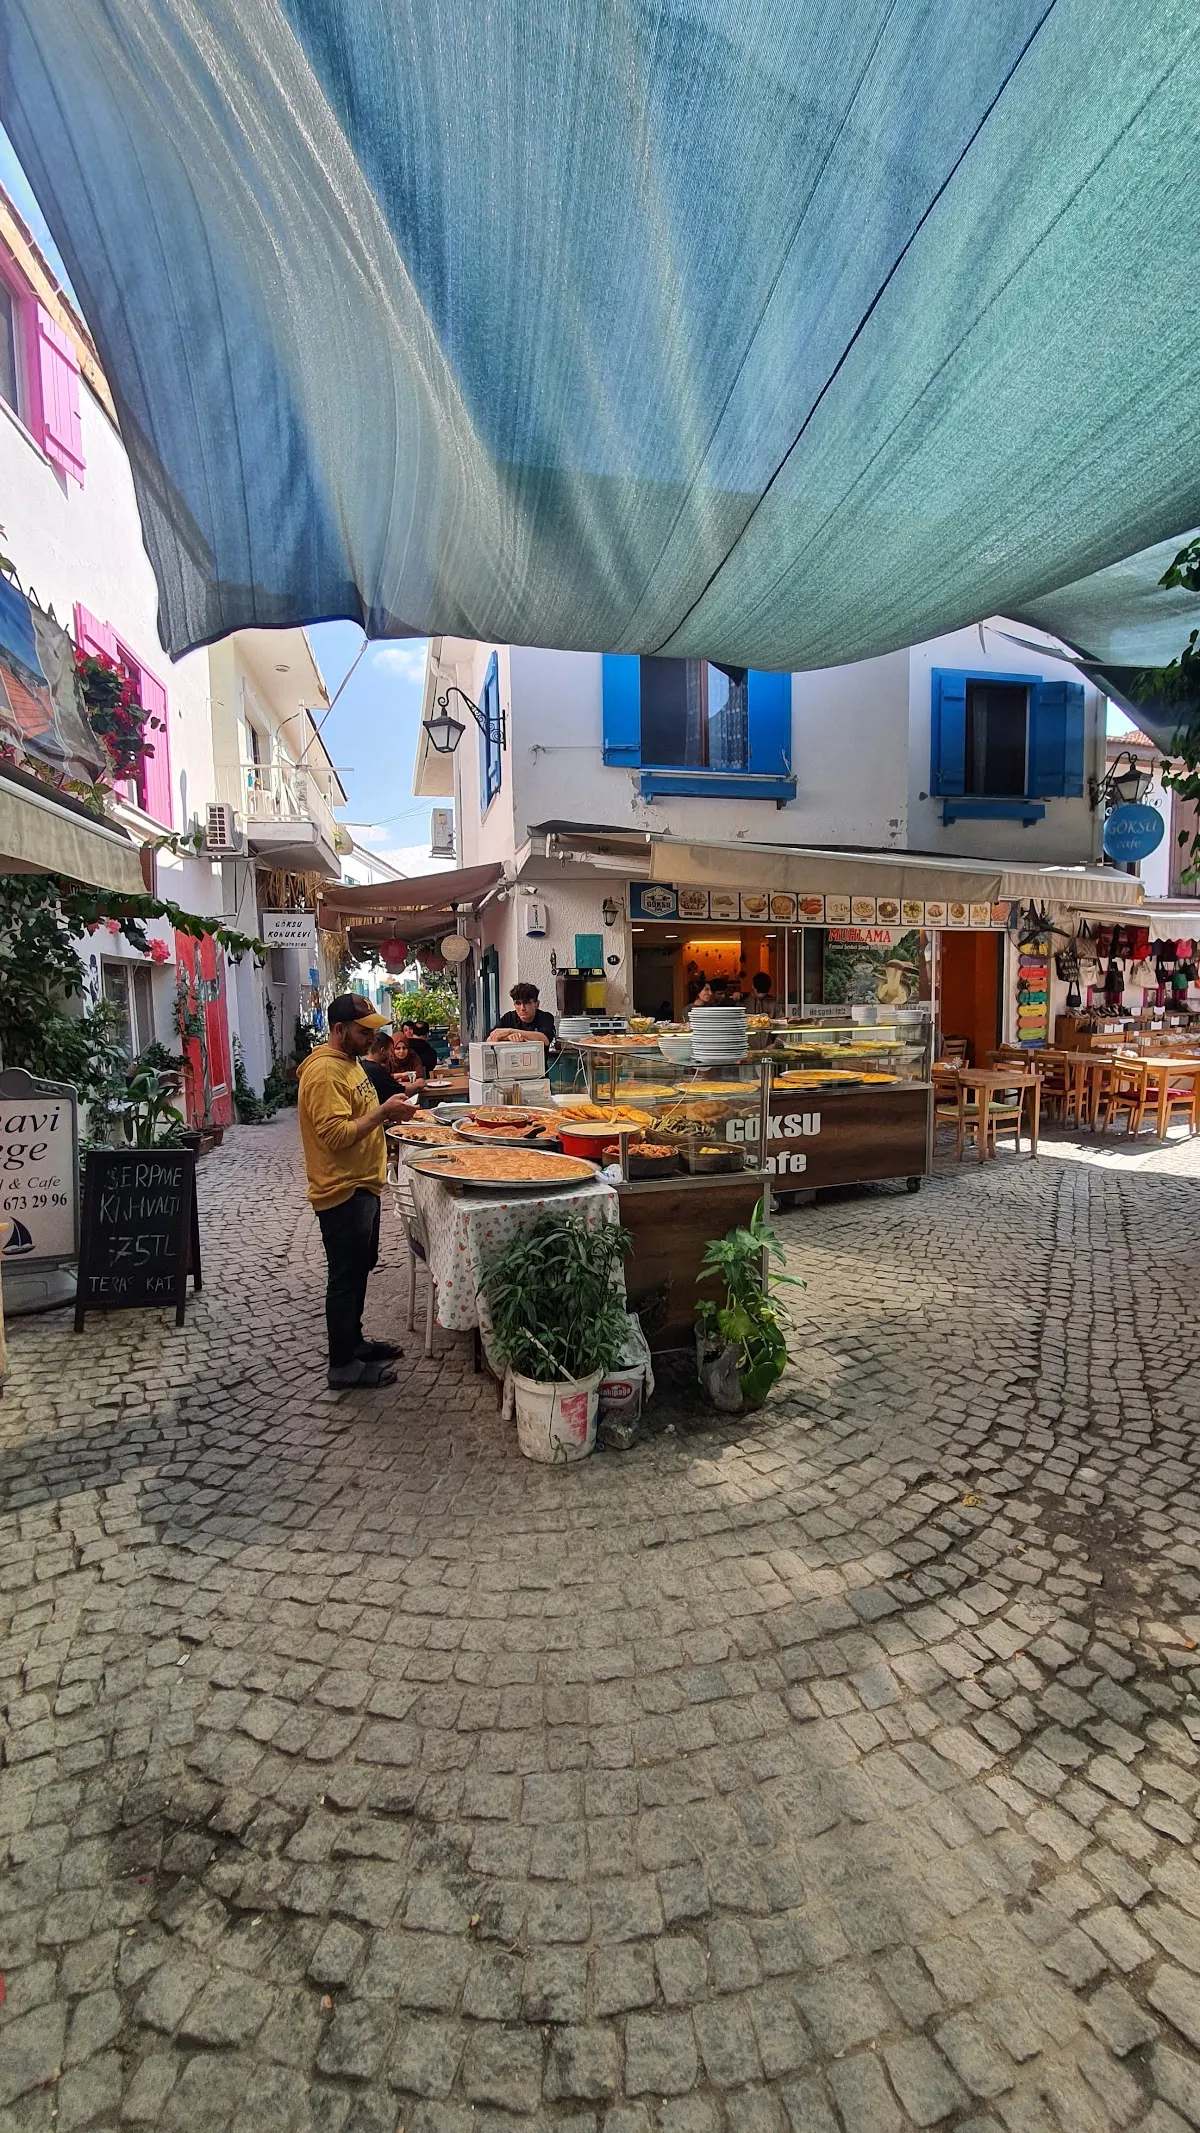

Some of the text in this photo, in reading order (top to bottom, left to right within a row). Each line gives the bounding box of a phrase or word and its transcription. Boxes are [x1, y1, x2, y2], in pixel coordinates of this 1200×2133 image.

[0, 1106, 60, 1134] avi
[725, 1112, 821, 1143] GÖKSU
[0, 1142, 48, 1171] ge
[8, 1177, 21, 1190] &
[27, 1175, 61, 1190] Cafe
[104, 1163, 183, 1190] SERPME
[3, 1192, 68, 1216] 673 29 96
